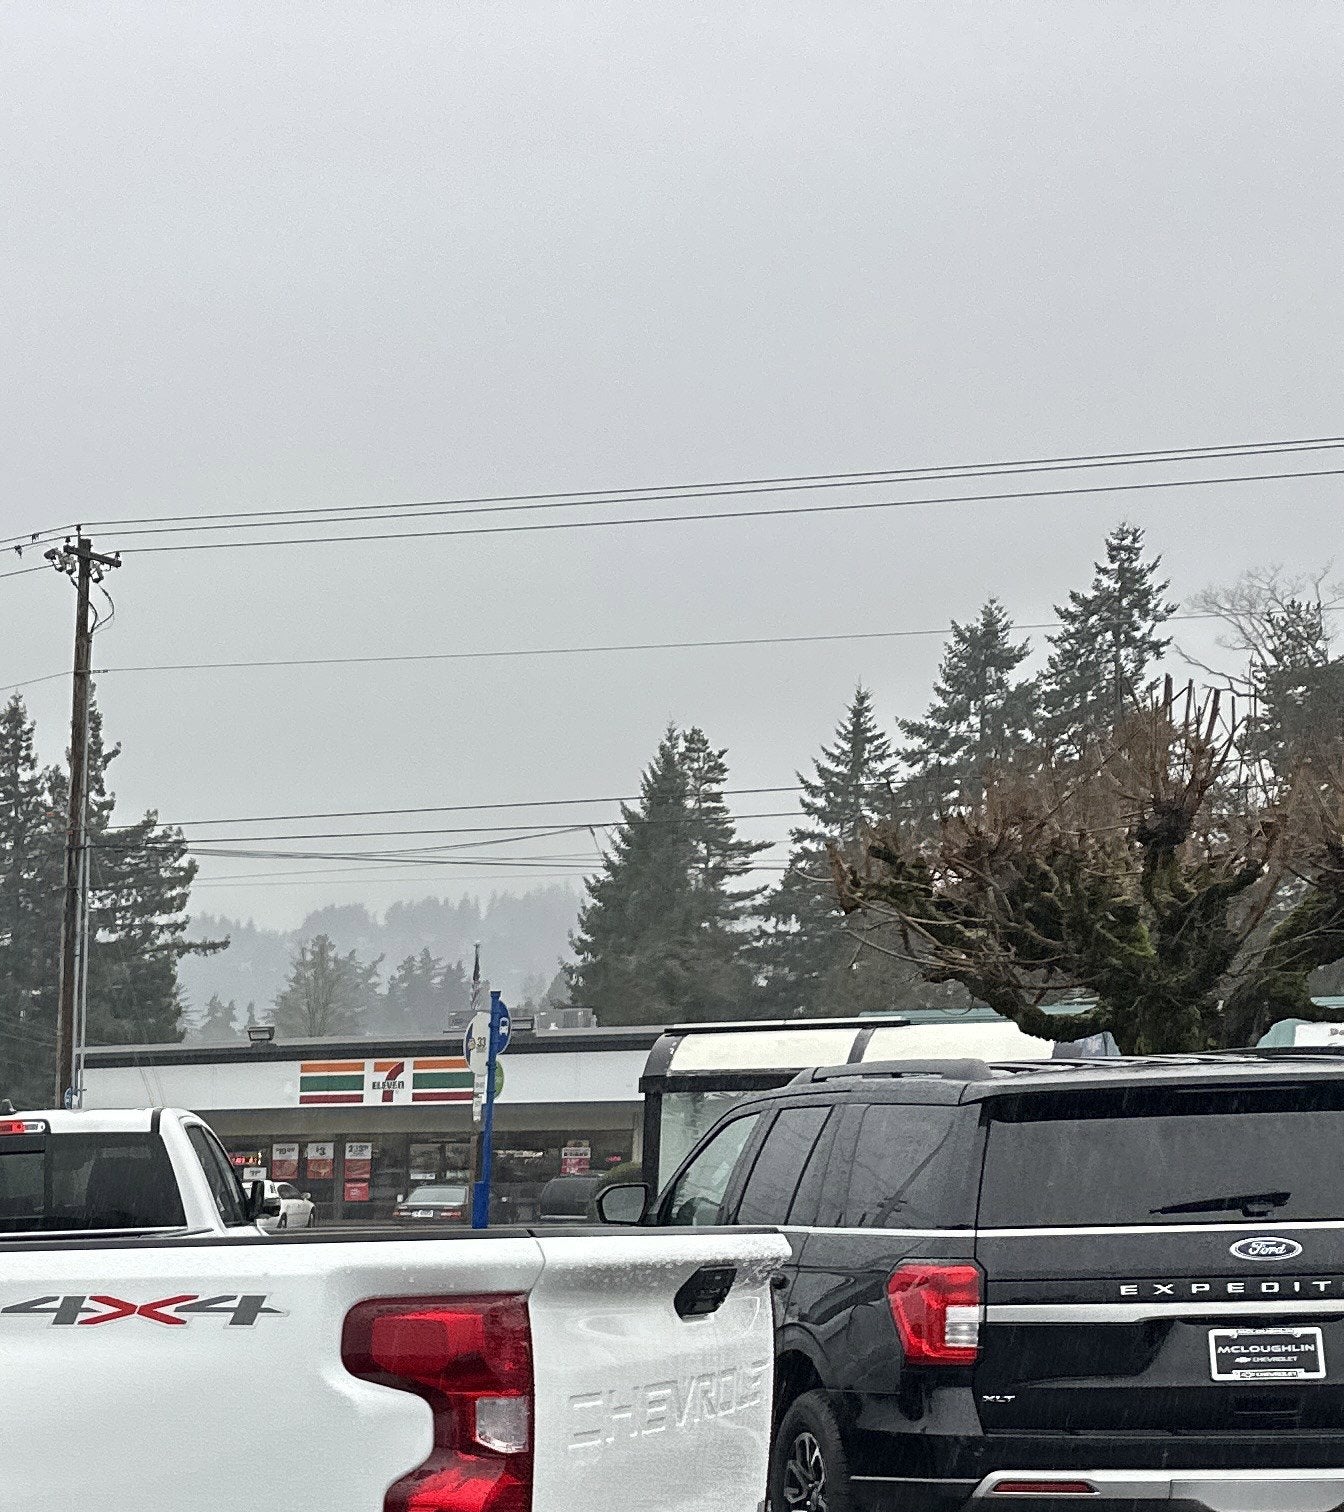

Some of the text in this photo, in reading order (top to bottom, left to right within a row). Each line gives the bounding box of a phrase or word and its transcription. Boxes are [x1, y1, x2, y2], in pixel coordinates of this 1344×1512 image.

[1248, 1241, 1287, 1256] Ford
[1120, 1281, 1344, 1296] EXPEDIT
[1217, 1344, 1315, 1354] MCLOUGHLIN
[982, 1395, 1016, 1403] XLT
